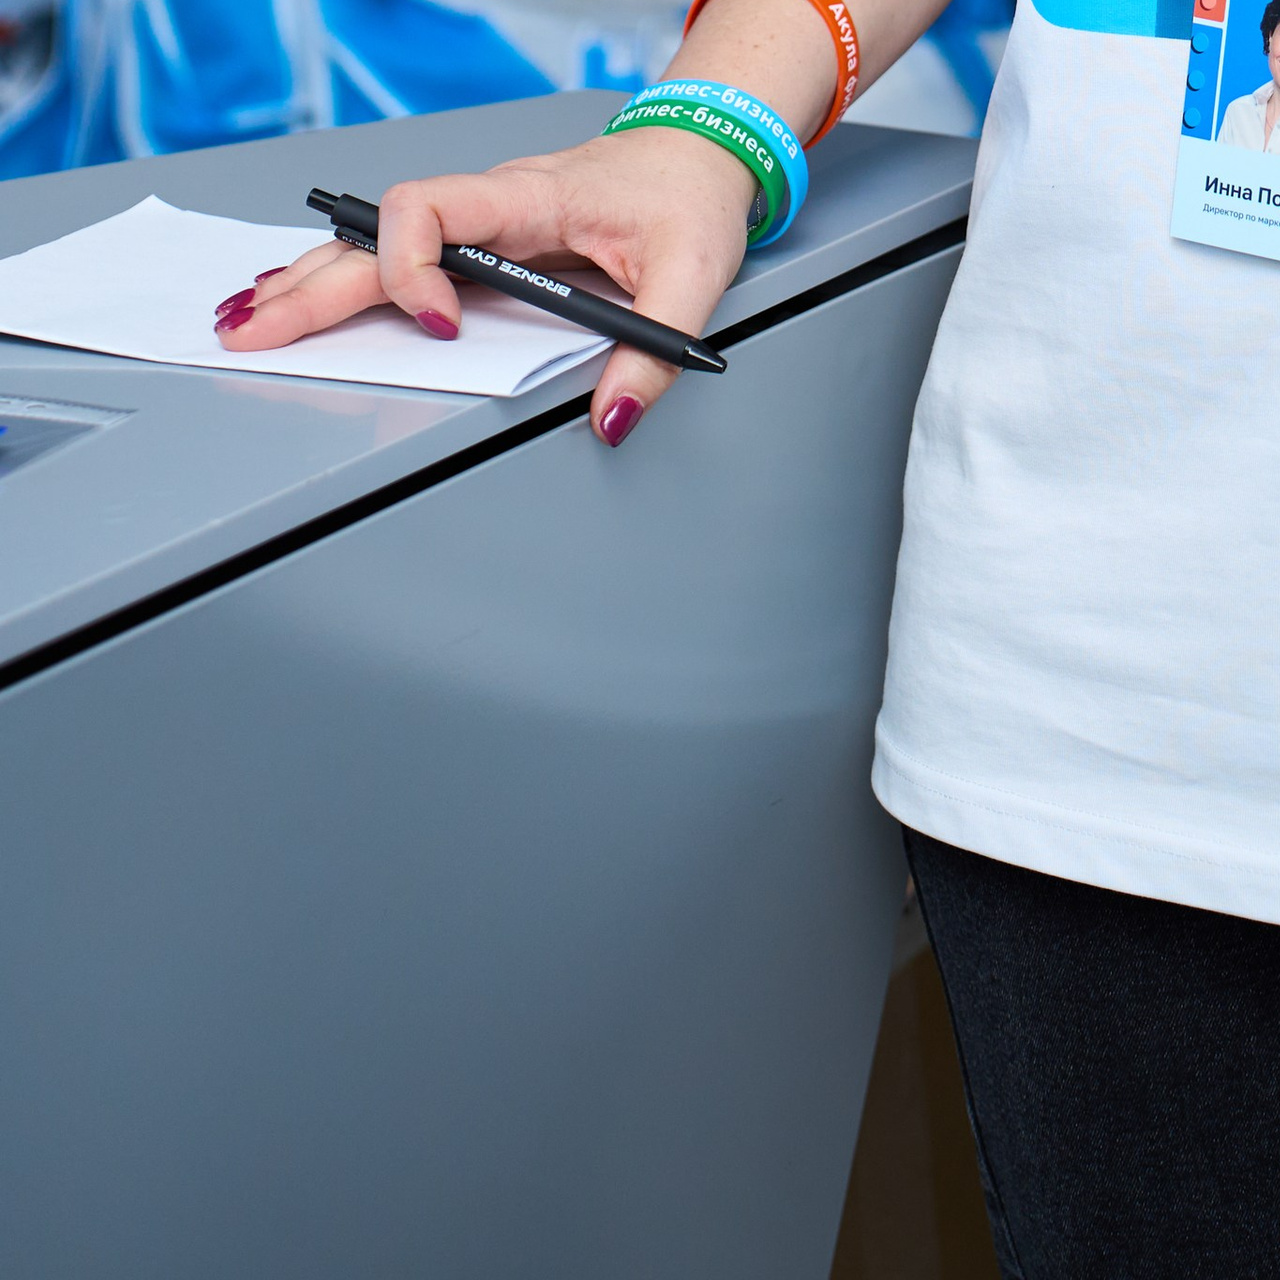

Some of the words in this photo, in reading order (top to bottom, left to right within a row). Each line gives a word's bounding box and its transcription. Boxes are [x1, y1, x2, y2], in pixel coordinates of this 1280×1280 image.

[828, 2, 857, 73] Акула
[611, 104, 775, 174] фитнес-бизнеса
[634, 83, 799, 160] фитнес-бизнеса
[1205, 175, 1253, 201] Инна
[1202, 203, 1244, 220] Директор
[1245, 213, 1256, 222] по
[458, 244, 497, 267] GYM
[498, 260, 572, 298] BRONZE
